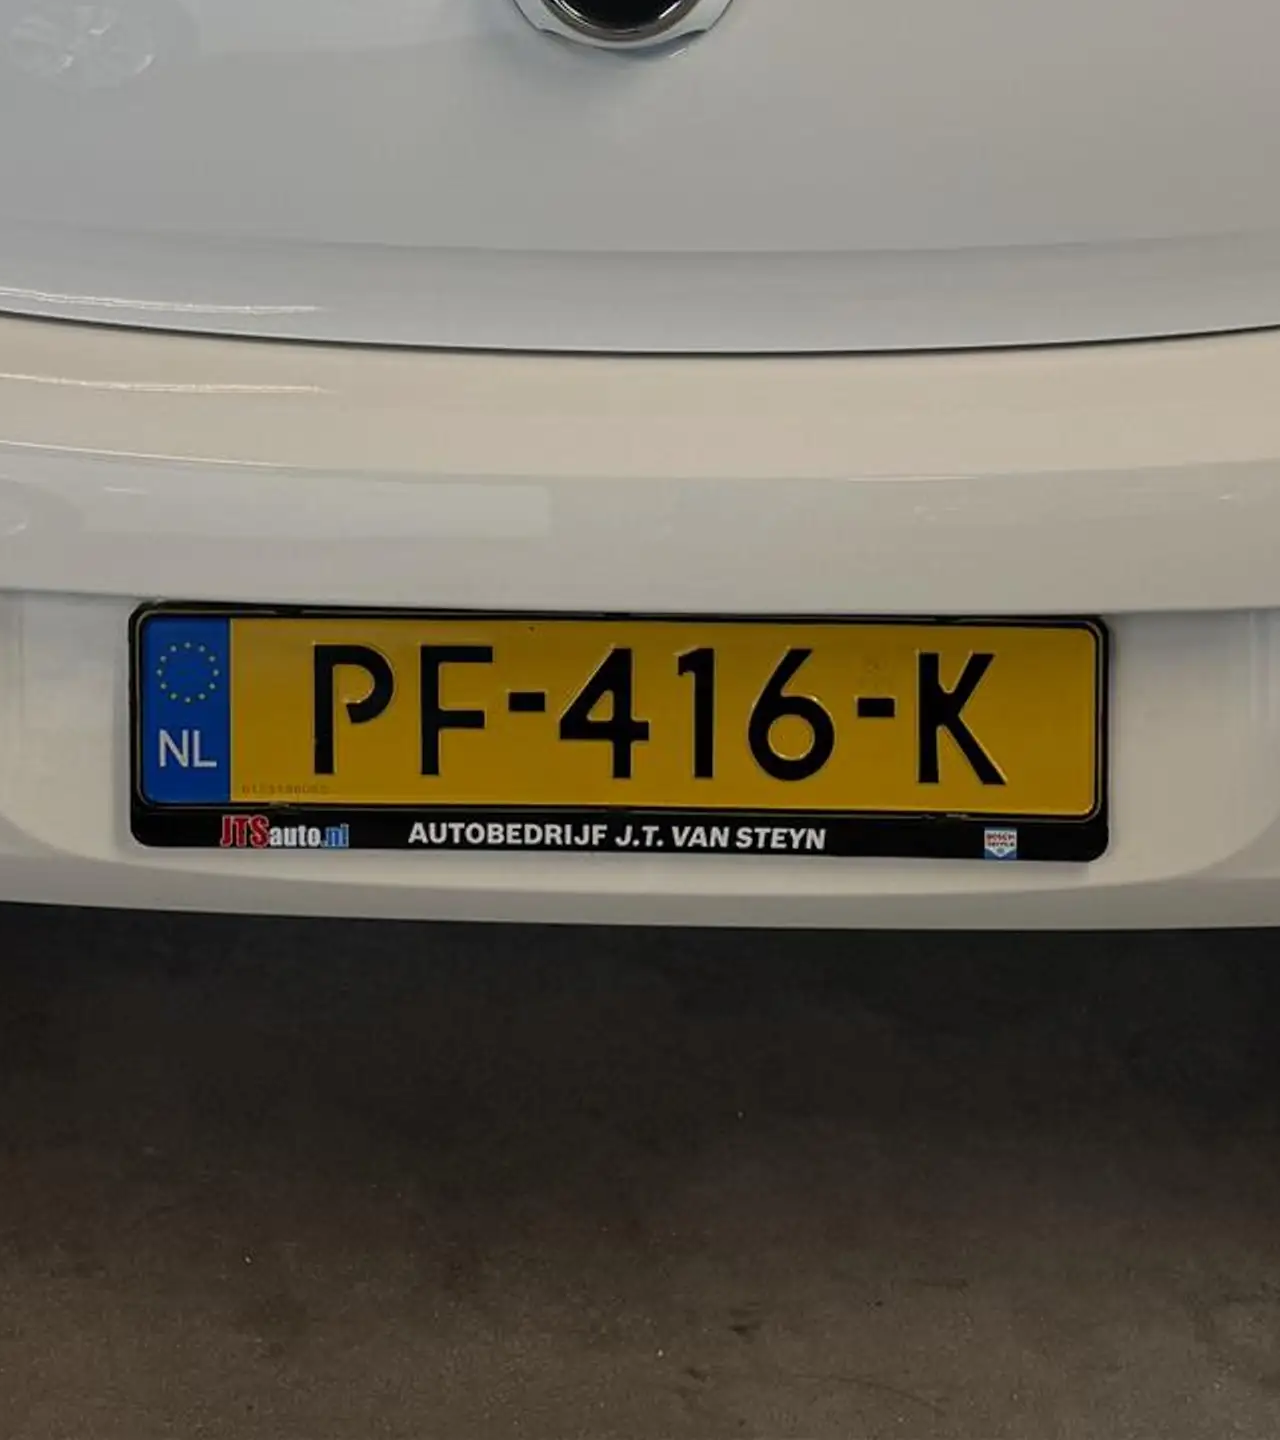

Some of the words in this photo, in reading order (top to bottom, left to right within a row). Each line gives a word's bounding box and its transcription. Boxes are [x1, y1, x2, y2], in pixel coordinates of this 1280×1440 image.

[313, 643, 1007, 786] PF-416-K
[159, 729, 217, 767] NL
[408, 822, 608, 846] AUTOBEDRIJF
[615, 825, 664, 847] J.T.
[671, 825, 730, 848] VAN
[735, 827, 826, 850] STEYN
